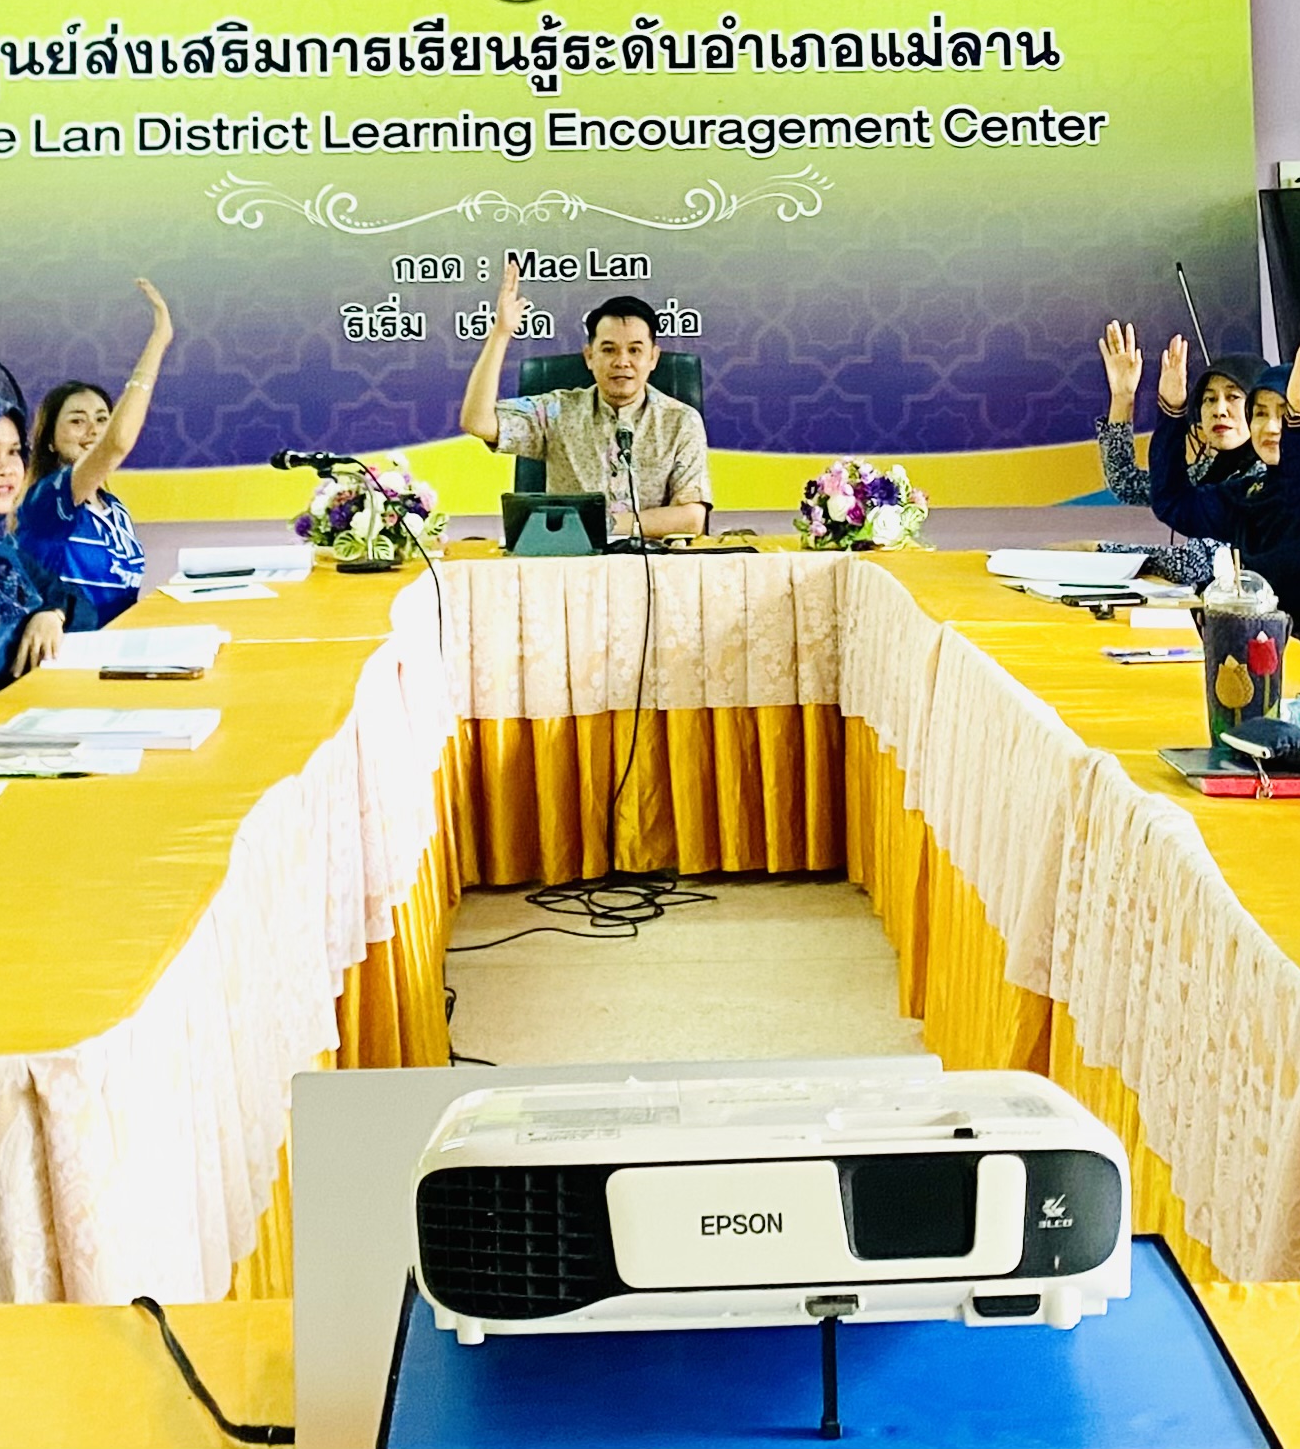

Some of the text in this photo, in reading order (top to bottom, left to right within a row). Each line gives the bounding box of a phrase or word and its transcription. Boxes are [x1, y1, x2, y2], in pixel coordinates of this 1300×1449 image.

[34, 118, 121, 153] Lan
[138, 115, 309, 152] District
[324, 112, 532, 158] Learning
[548, 109, 933, 156] Encouragement
[943, 107, 1107, 150] Center
[394, 256, 462, 281] กอด
[507, 250, 579, 279] Mae
[588, 250, 650, 278] Lan
[342, 295, 424, 339] ริเริ่ม
[700, 1211, 784, 1237] EPSON
